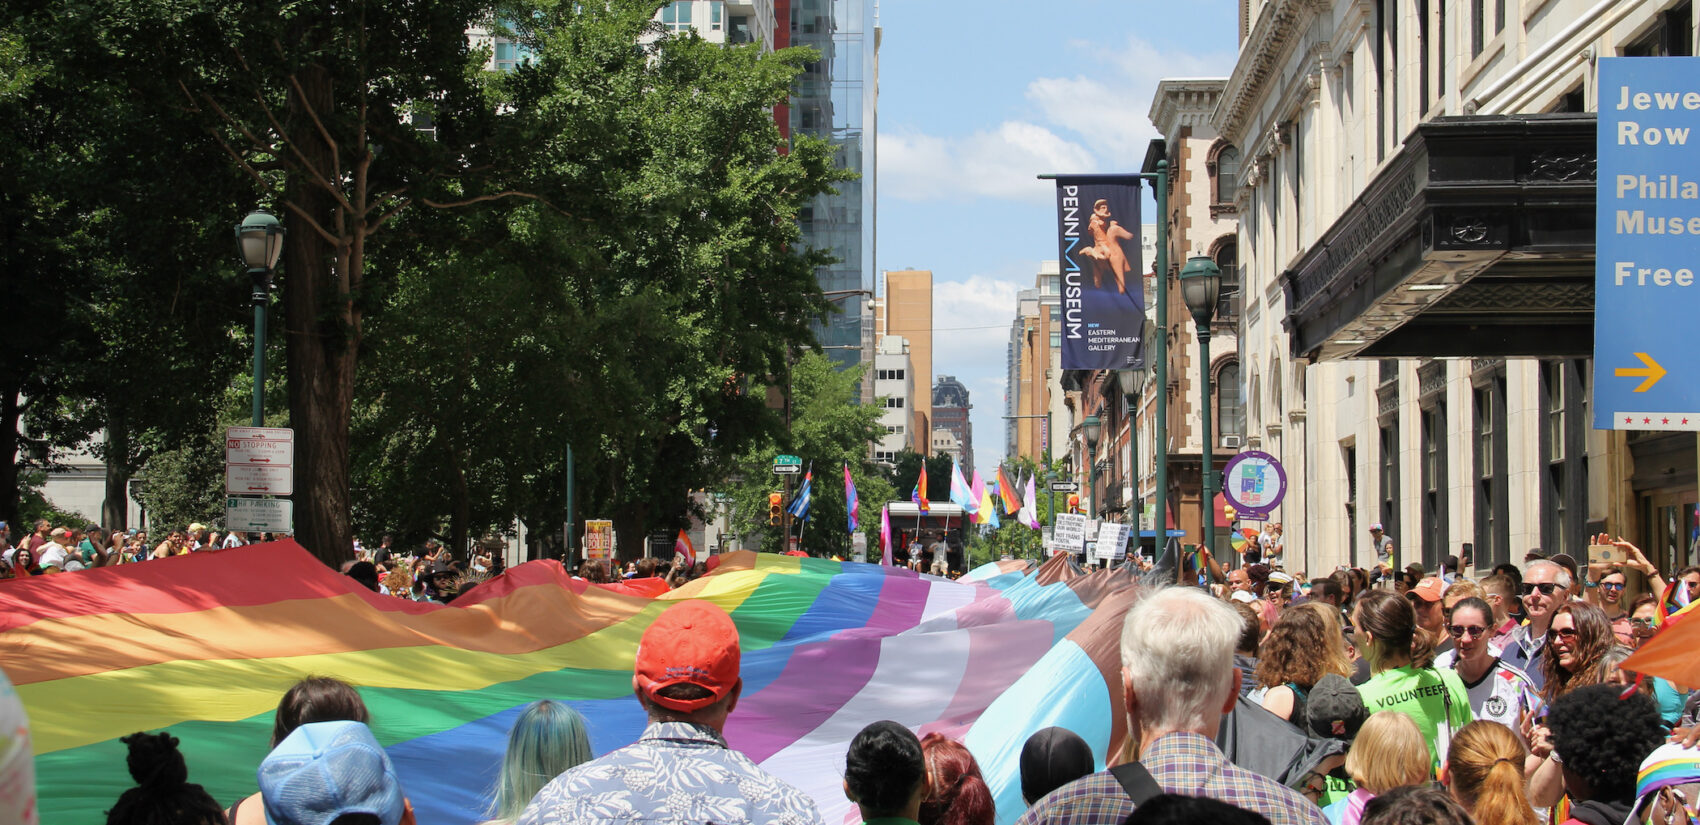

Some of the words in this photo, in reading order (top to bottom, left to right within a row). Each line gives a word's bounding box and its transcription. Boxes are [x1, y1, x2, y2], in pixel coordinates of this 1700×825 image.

[1617, 86, 1700, 110] Jewe
[1618, 121, 1690, 145] Row
[1616, 174, 1698, 199] Phila
[1616, 210, 1700, 235] Muse
[1615, 262, 1694, 286] Free
[229, 440, 239, 448] NO
[243, 441, 277, 449] STOPPING
[231, 499, 236, 507] 2
[250, 500, 280, 508] PARKING
